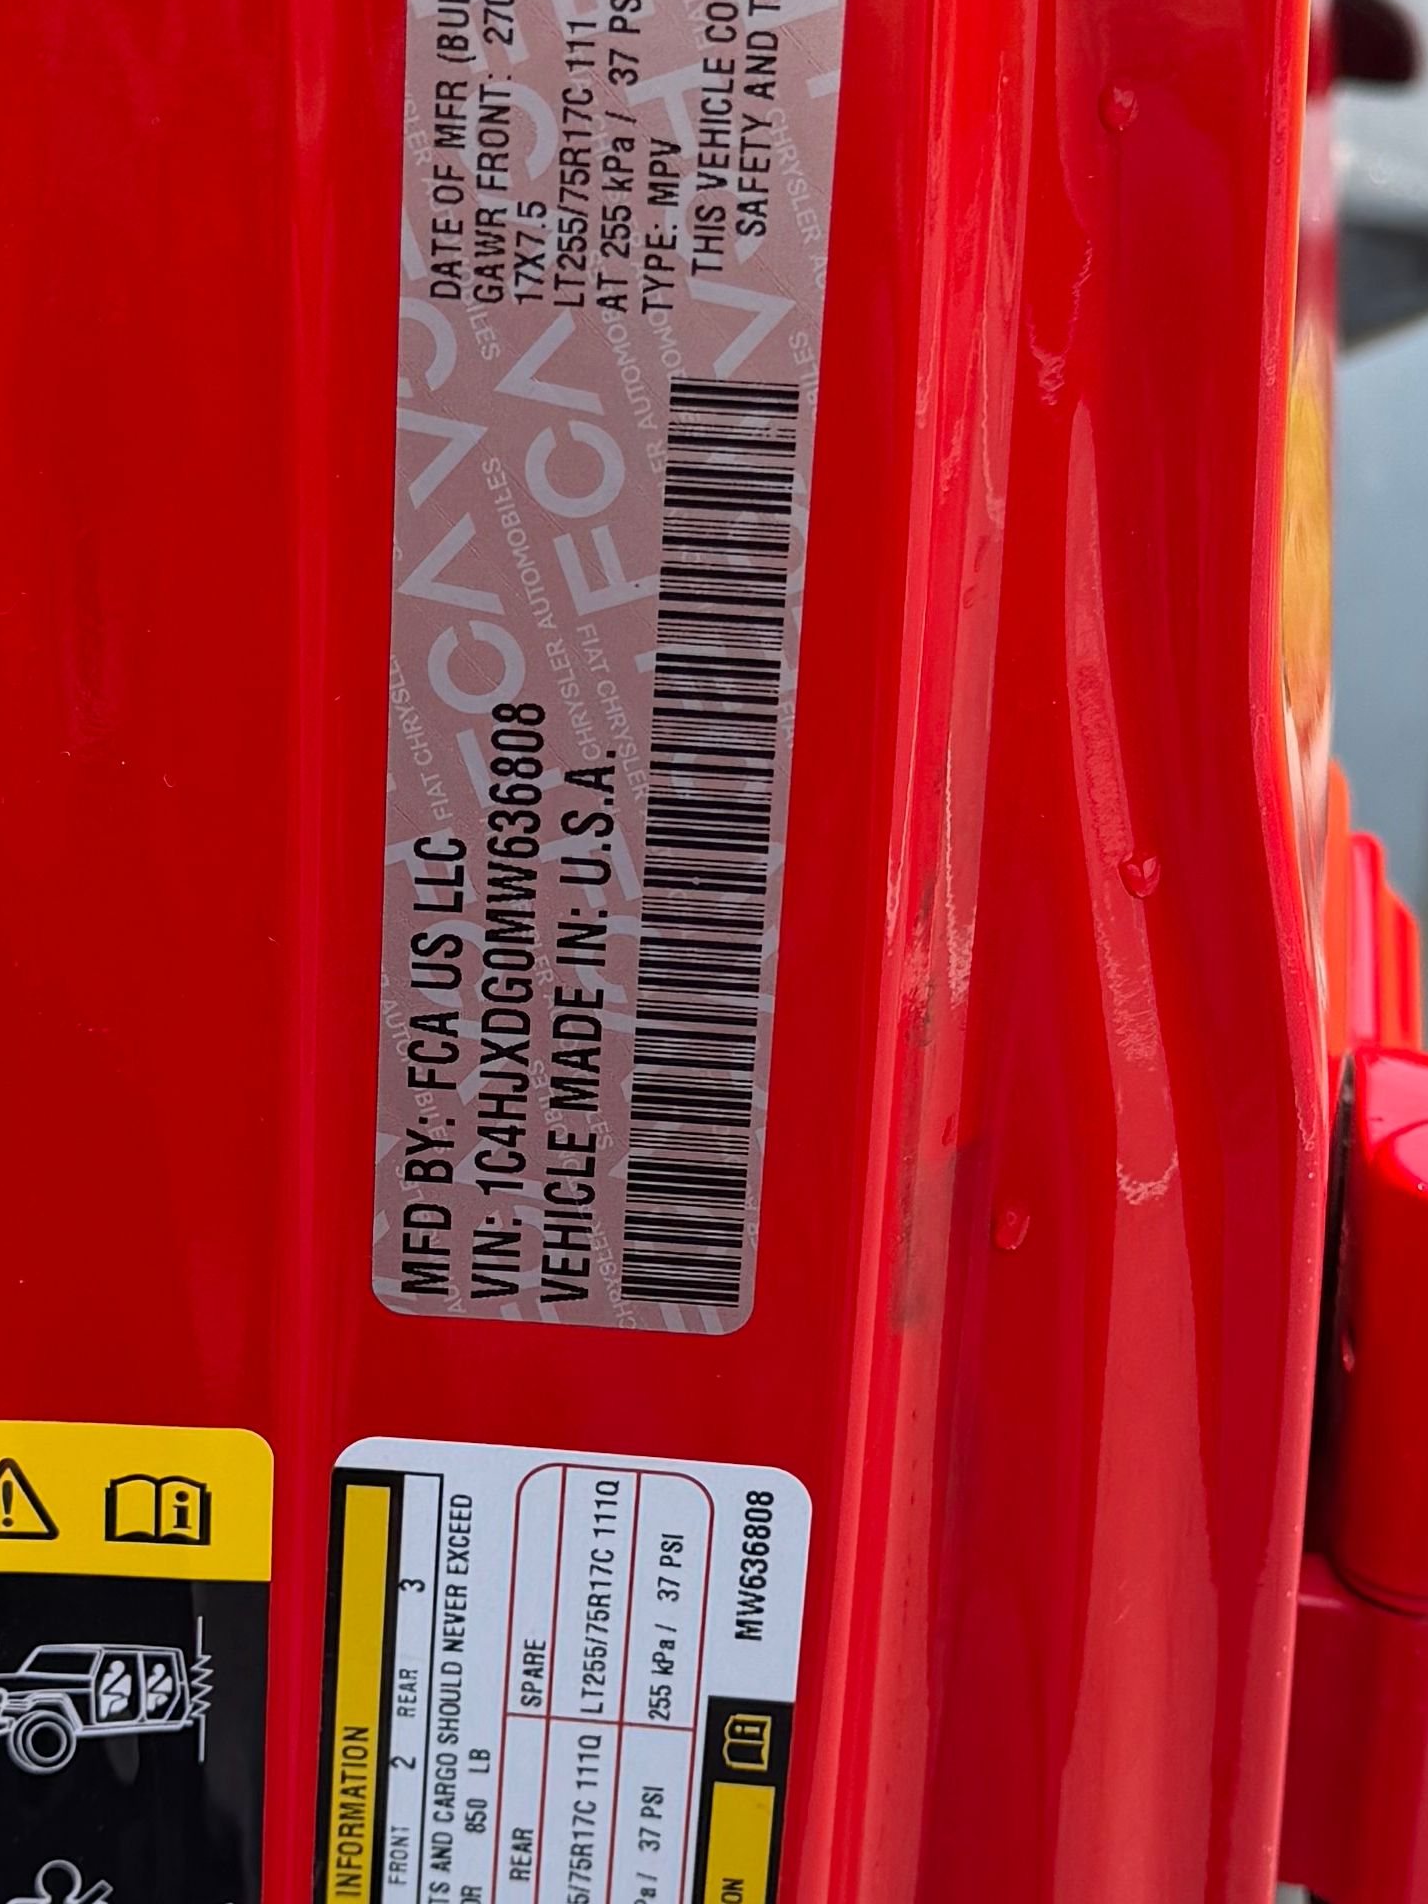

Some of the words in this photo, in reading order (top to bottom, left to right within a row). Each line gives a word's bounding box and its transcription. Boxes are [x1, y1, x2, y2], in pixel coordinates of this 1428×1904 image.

[565, 21, 597, 72] 111
[608, 48, 639, 86] 37
[744, 31, 778, 101] AND
[433, 81, 468, 149] MFR
[476, 73, 512, 191] FRONT:
[696, 57, 735, 191] VEHICLE
[433, 164, 465, 205] OF
[553, 88, 593, 307] LT255/75R17C
[601, 137, 635, 192] kPa
[647, 137, 681, 207] MPV
[735, 113, 772, 237] SAFETY
[429, 218, 463, 300] DATE
[473, 208, 507, 304] GAWR
[513, 201, 547, 305] 17X7.5
[600, 205, 632, 259] 255
[691, 205, 726, 277] THIS
[596, 272, 628, 313] AT
[641, 224, 677, 315] TYPE:
[560, 750, 616, 885] U.S.A.
[413, 837, 467, 913] LLC
[411, 933, 463, 989] US
[480, 703, 545, 1199] 1C4HJXDG0MW636808
[556, 908, 608, 967] IN:
[407, 1011, 459, 1090] FCA
[549, 986, 604, 1111] MADE
[404, 1116, 455, 1184] BY:
[401, 1203, 451, 1296] MFD
[540, 1130, 597, 1303] VEHICLE
[470, 1216, 522, 1299] VIN:
[446, 1494, 472, 1575] EXCEED
[593, 1480, 619, 1538] 111Q
[659, 1533, 684, 1568] PSI
[735, 1491, 774, 1641] MW636808
[399, 1577, 424, 1594] 3
[442, 1584, 467, 1652] NEVER
[657, 1576, 680, 1602] 37
[580, 1548, 614, 1714] LT255/75R17C
[651, 1640, 675, 1675] kPa
[397, 1669, 418, 1718] REAR
[437, 1662, 462, 1745] SHOULD
[520, 1639, 546, 1707] SPARE
[648, 1685, 672, 1721] 255
[390, 1756, 415, 1772] 2
[433, 1753, 458, 1823] CARGO
[468, 1749, 490, 1774] LB
[576, 1735, 602, 1789] 111Q
[336, 1726, 369, 1896] INFORMATION
[465, 1798, 487, 1834] 850
[640, 1786, 664, 1819] PSI
[388, 1826, 410, 1886] FRONT
[430, 1832, 453, 1873] AND
[509, 1828, 533, 1882] REAR
[638, 1827, 661, 1852] 37
